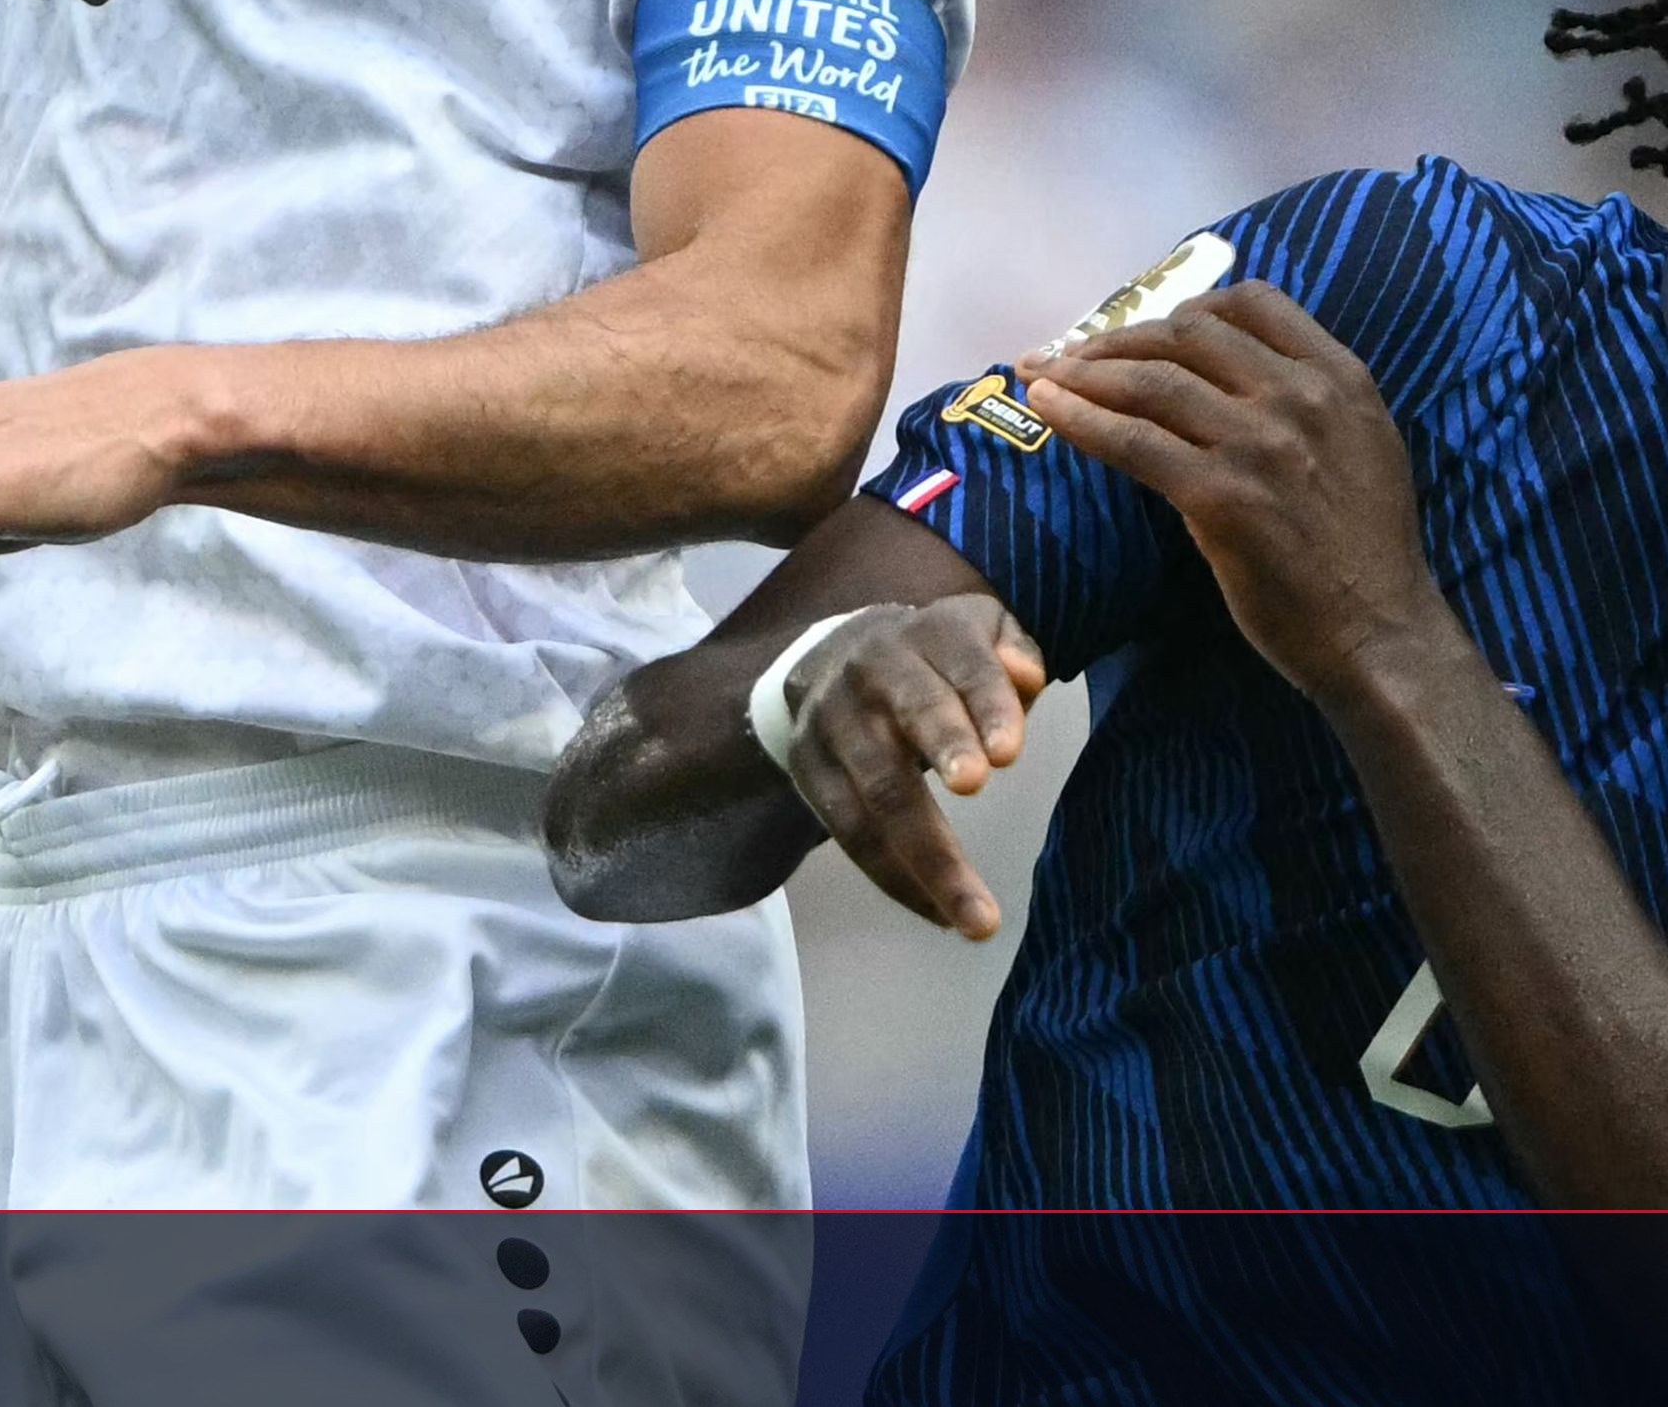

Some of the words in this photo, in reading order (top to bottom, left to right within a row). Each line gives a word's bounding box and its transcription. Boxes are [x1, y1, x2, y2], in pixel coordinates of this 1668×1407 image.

[681, 40, 760, 87] the
[769, 39, 903, 114] World
[755, 92, 828, 119] FIFA
[981, 397, 1043, 434] DEBUT
